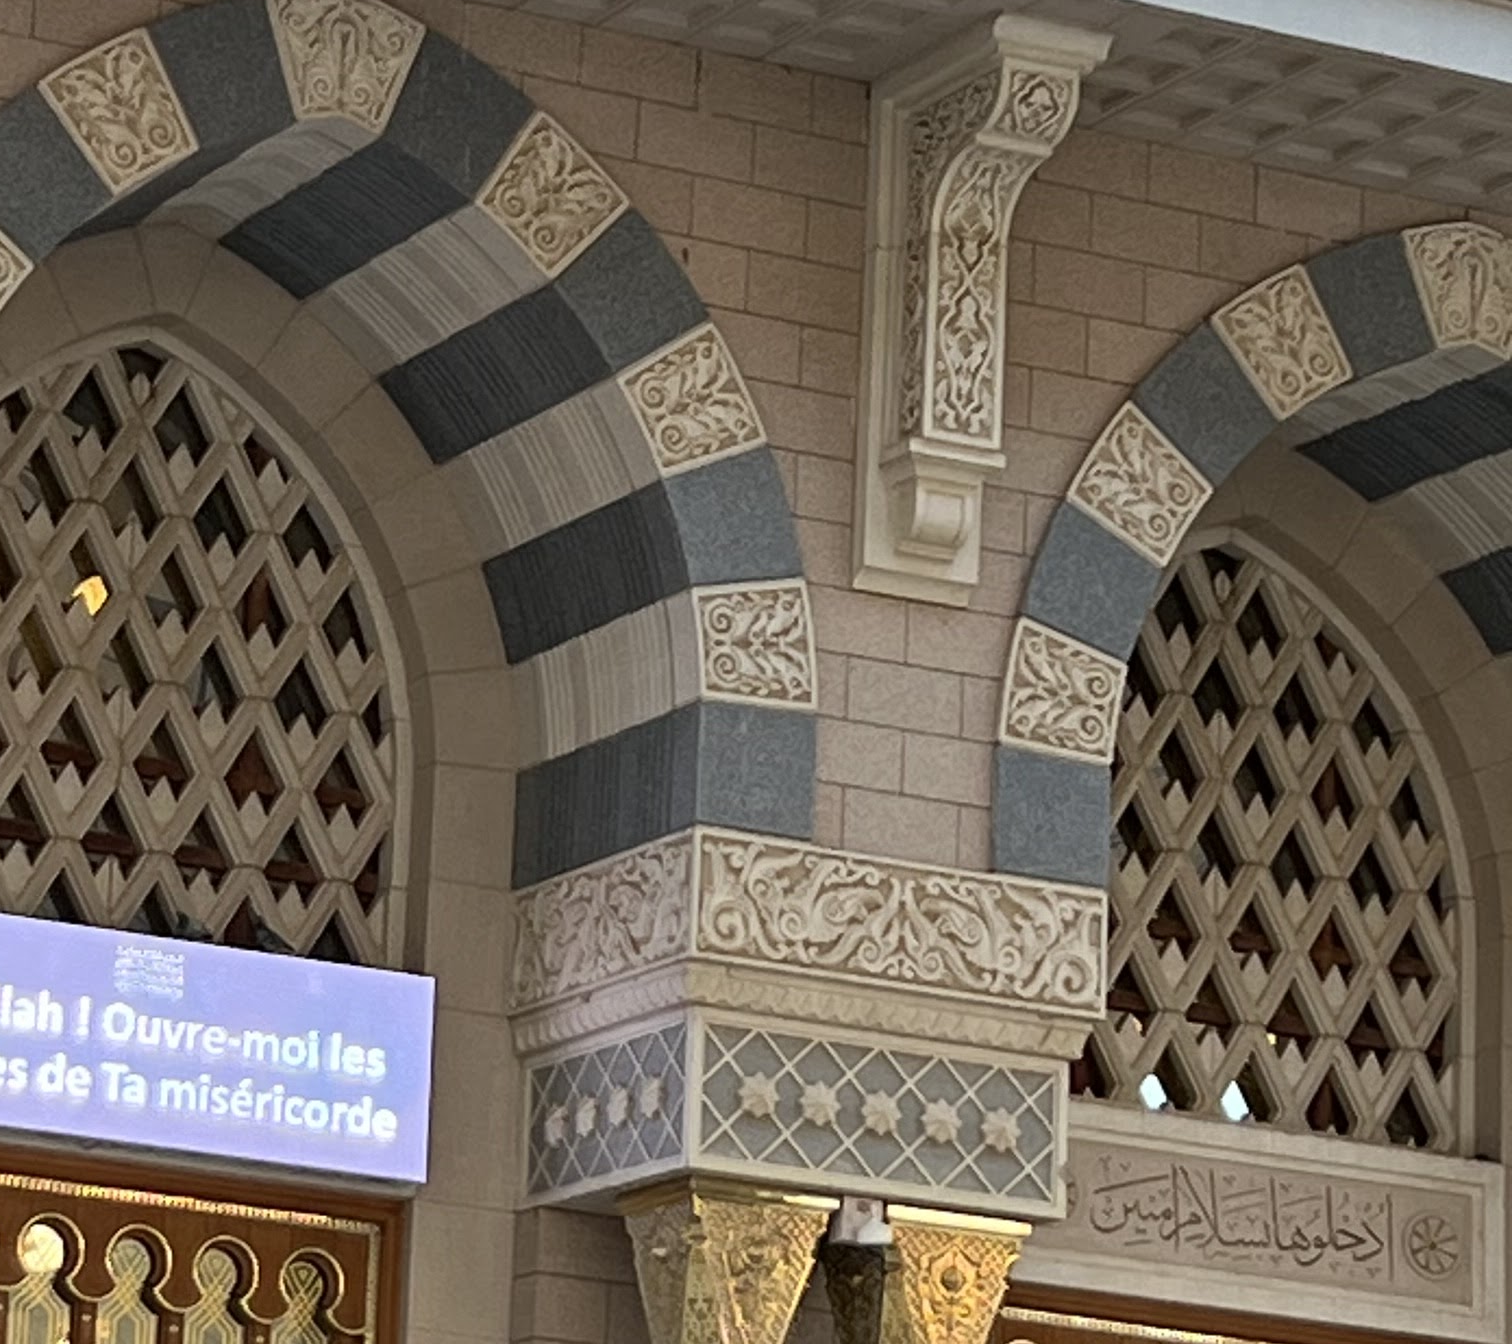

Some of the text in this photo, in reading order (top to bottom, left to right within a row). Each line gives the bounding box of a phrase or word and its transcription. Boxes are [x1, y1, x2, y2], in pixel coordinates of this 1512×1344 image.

[76, 996, 92, 1038] !
[102, 1001, 319, 1069] Ouvre-moi
[329, 1032, 386, 1078] les
[35, 1053, 92, 1101] de
[100, 1061, 148, 1107] Ta
[159, 1073, 398, 1143] miséricorde
